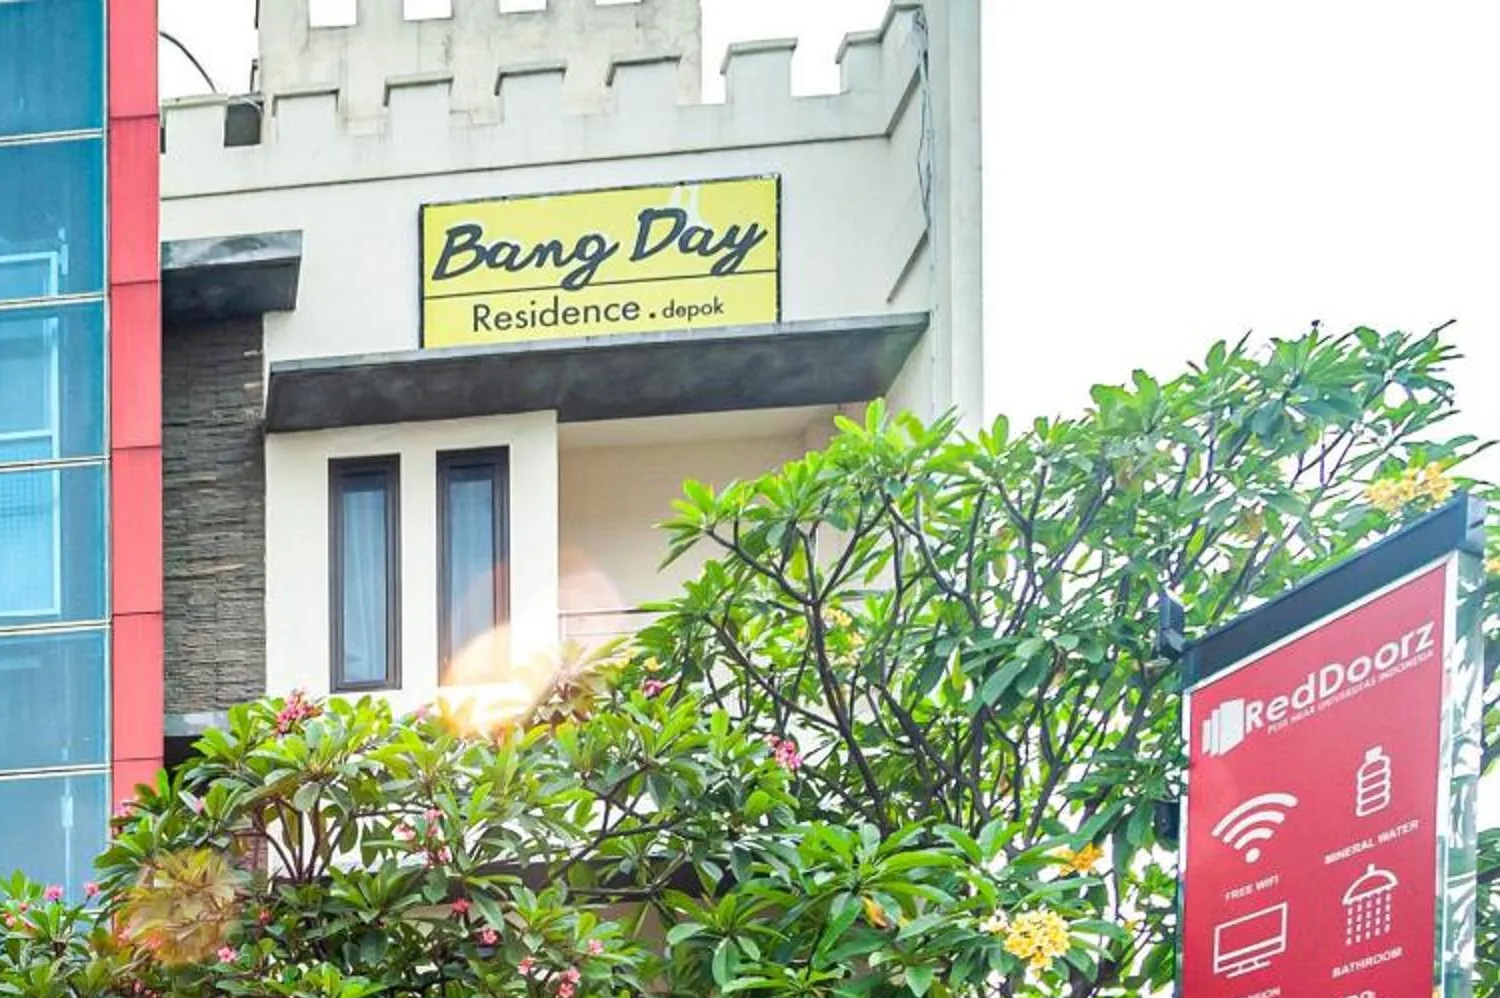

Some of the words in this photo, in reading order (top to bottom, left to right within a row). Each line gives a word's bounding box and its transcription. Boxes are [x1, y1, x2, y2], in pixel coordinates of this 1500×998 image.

[431, 223, 619, 290] Bang
[629, 207, 768, 276] Day
[473, 295, 640, 332] Residence
[1245, 622, 1435, 733] RedDoorz
[1324, 838, 1375, 865] MINERAL
[1377, 819, 1419, 844] WATER
[1225, 884, 1254, 902] FREE
[1255, 874, 1279, 891] WIFI
[1331, 947, 1404, 979] BATHROOM
